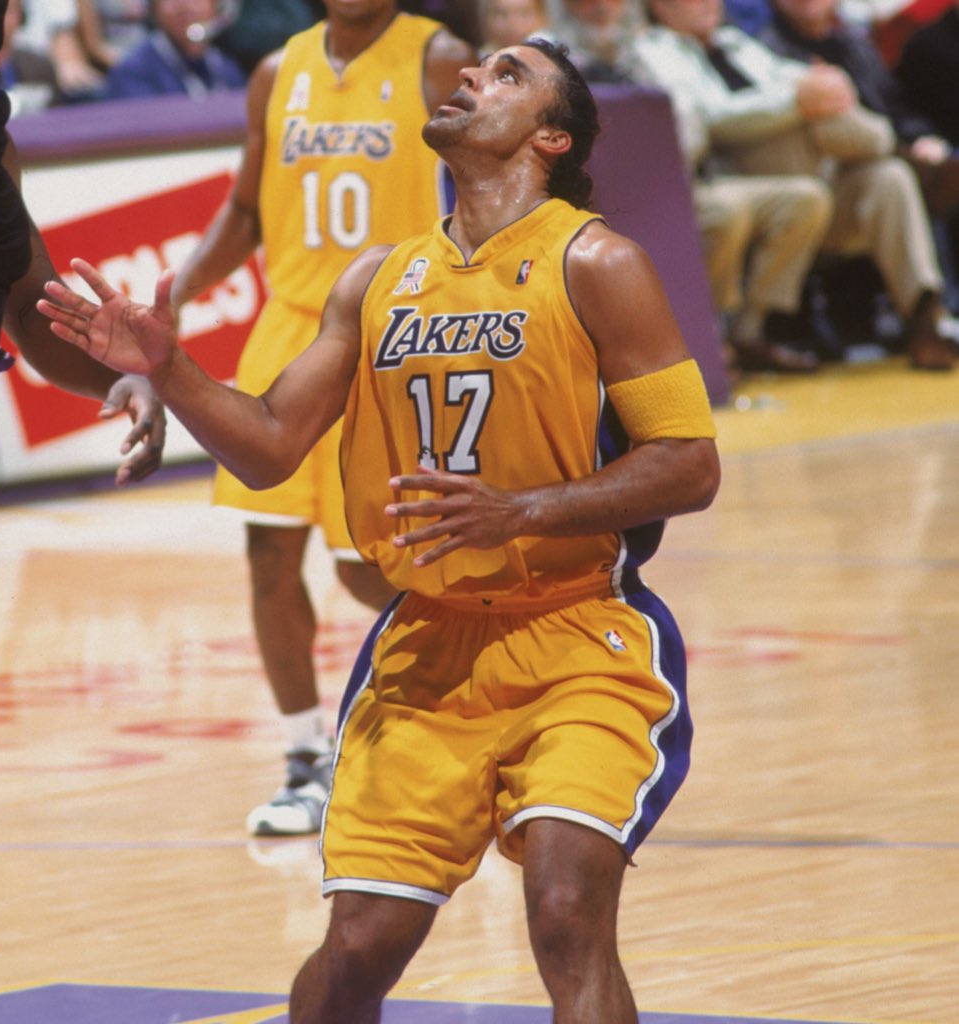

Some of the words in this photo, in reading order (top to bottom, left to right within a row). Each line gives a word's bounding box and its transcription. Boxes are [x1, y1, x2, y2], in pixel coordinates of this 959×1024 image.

[281, 116, 395, 165] LAKERS
[303, 171, 371, 248] 10
[374, 306, 528, 371] LAKERS
[406, 370, 494, 474] 17
